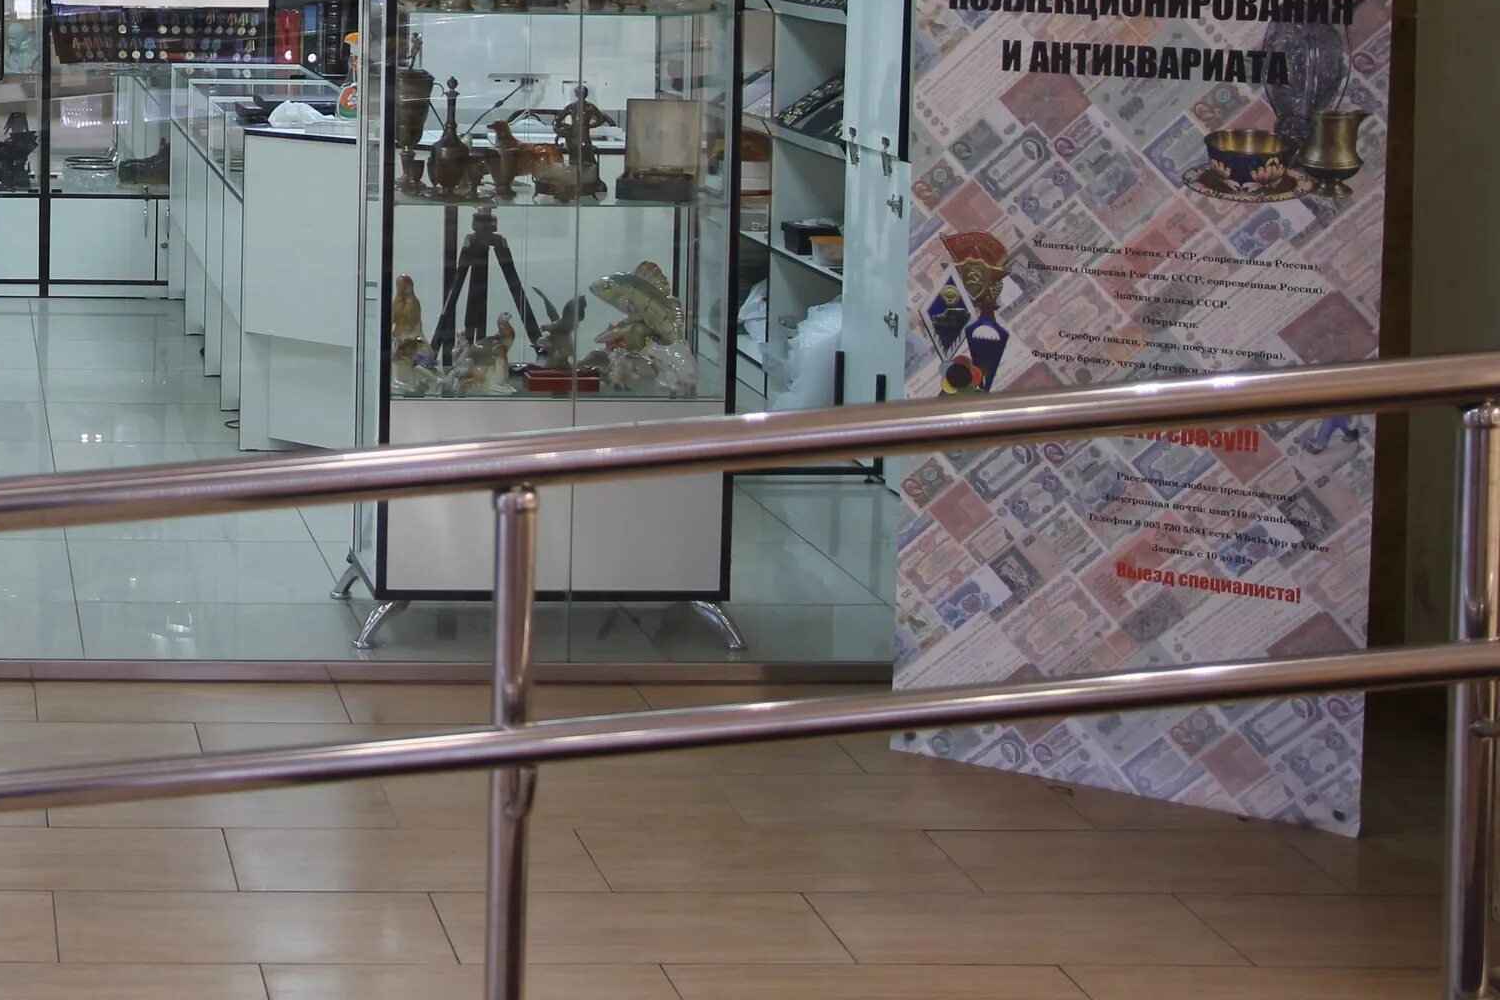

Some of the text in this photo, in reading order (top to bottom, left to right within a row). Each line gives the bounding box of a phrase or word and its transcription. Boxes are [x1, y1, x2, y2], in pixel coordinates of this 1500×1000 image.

[1001, 40, 1290, 85] И АНТИКВАРИАТА
[1032, 239, 1321, 271] Монеты (царская Россия, СССР, современная Россия).
[1027, 261, 1326, 296] Банкноты (царская Россия, СССР, современная Россия).
[1113, 290, 1151, 302] Значки
[1196, 298, 1231, 310] СССР.
[1142, 315, 1199, 329] Открытки.
[1058, 329, 1101, 343] Серебро
[1143, 341, 1180, 350] ложки,
[1182, 345, 1219, 355] посуду
[1235, 349, 1287, 361] серебра).
[1031, 349, 1075, 362] Фарфор,
[1077, 355, 1115, 366] бронзу,
[1148, 362, 1199, 376] (фигурки
[1116, 471, 1179, 487] Рассмотрим
[1181, 483, 1219, 492] любые
[1102, 491, 1310, 528] Электронная почта: usm719@yanderu
[1087, 512, 1133, 526] Телефон
[1134, 519, 1142, 527] 8
[1143, 520, 1161, 530] 905
[1163, 523, 1181, 533] 730
[1183, 525, 1206, 536] 5881
[1208, 531, 1232, 539] есть
[1234, 532, 1288, 548] WhatsApp
[1300, 541, 1331, 553] Viber
[1151, 543, 1195, 557] Звонить
[1206, 551, 1217, 560] 10
[1116, 562, 1301, 604] Выезд специалиста!
